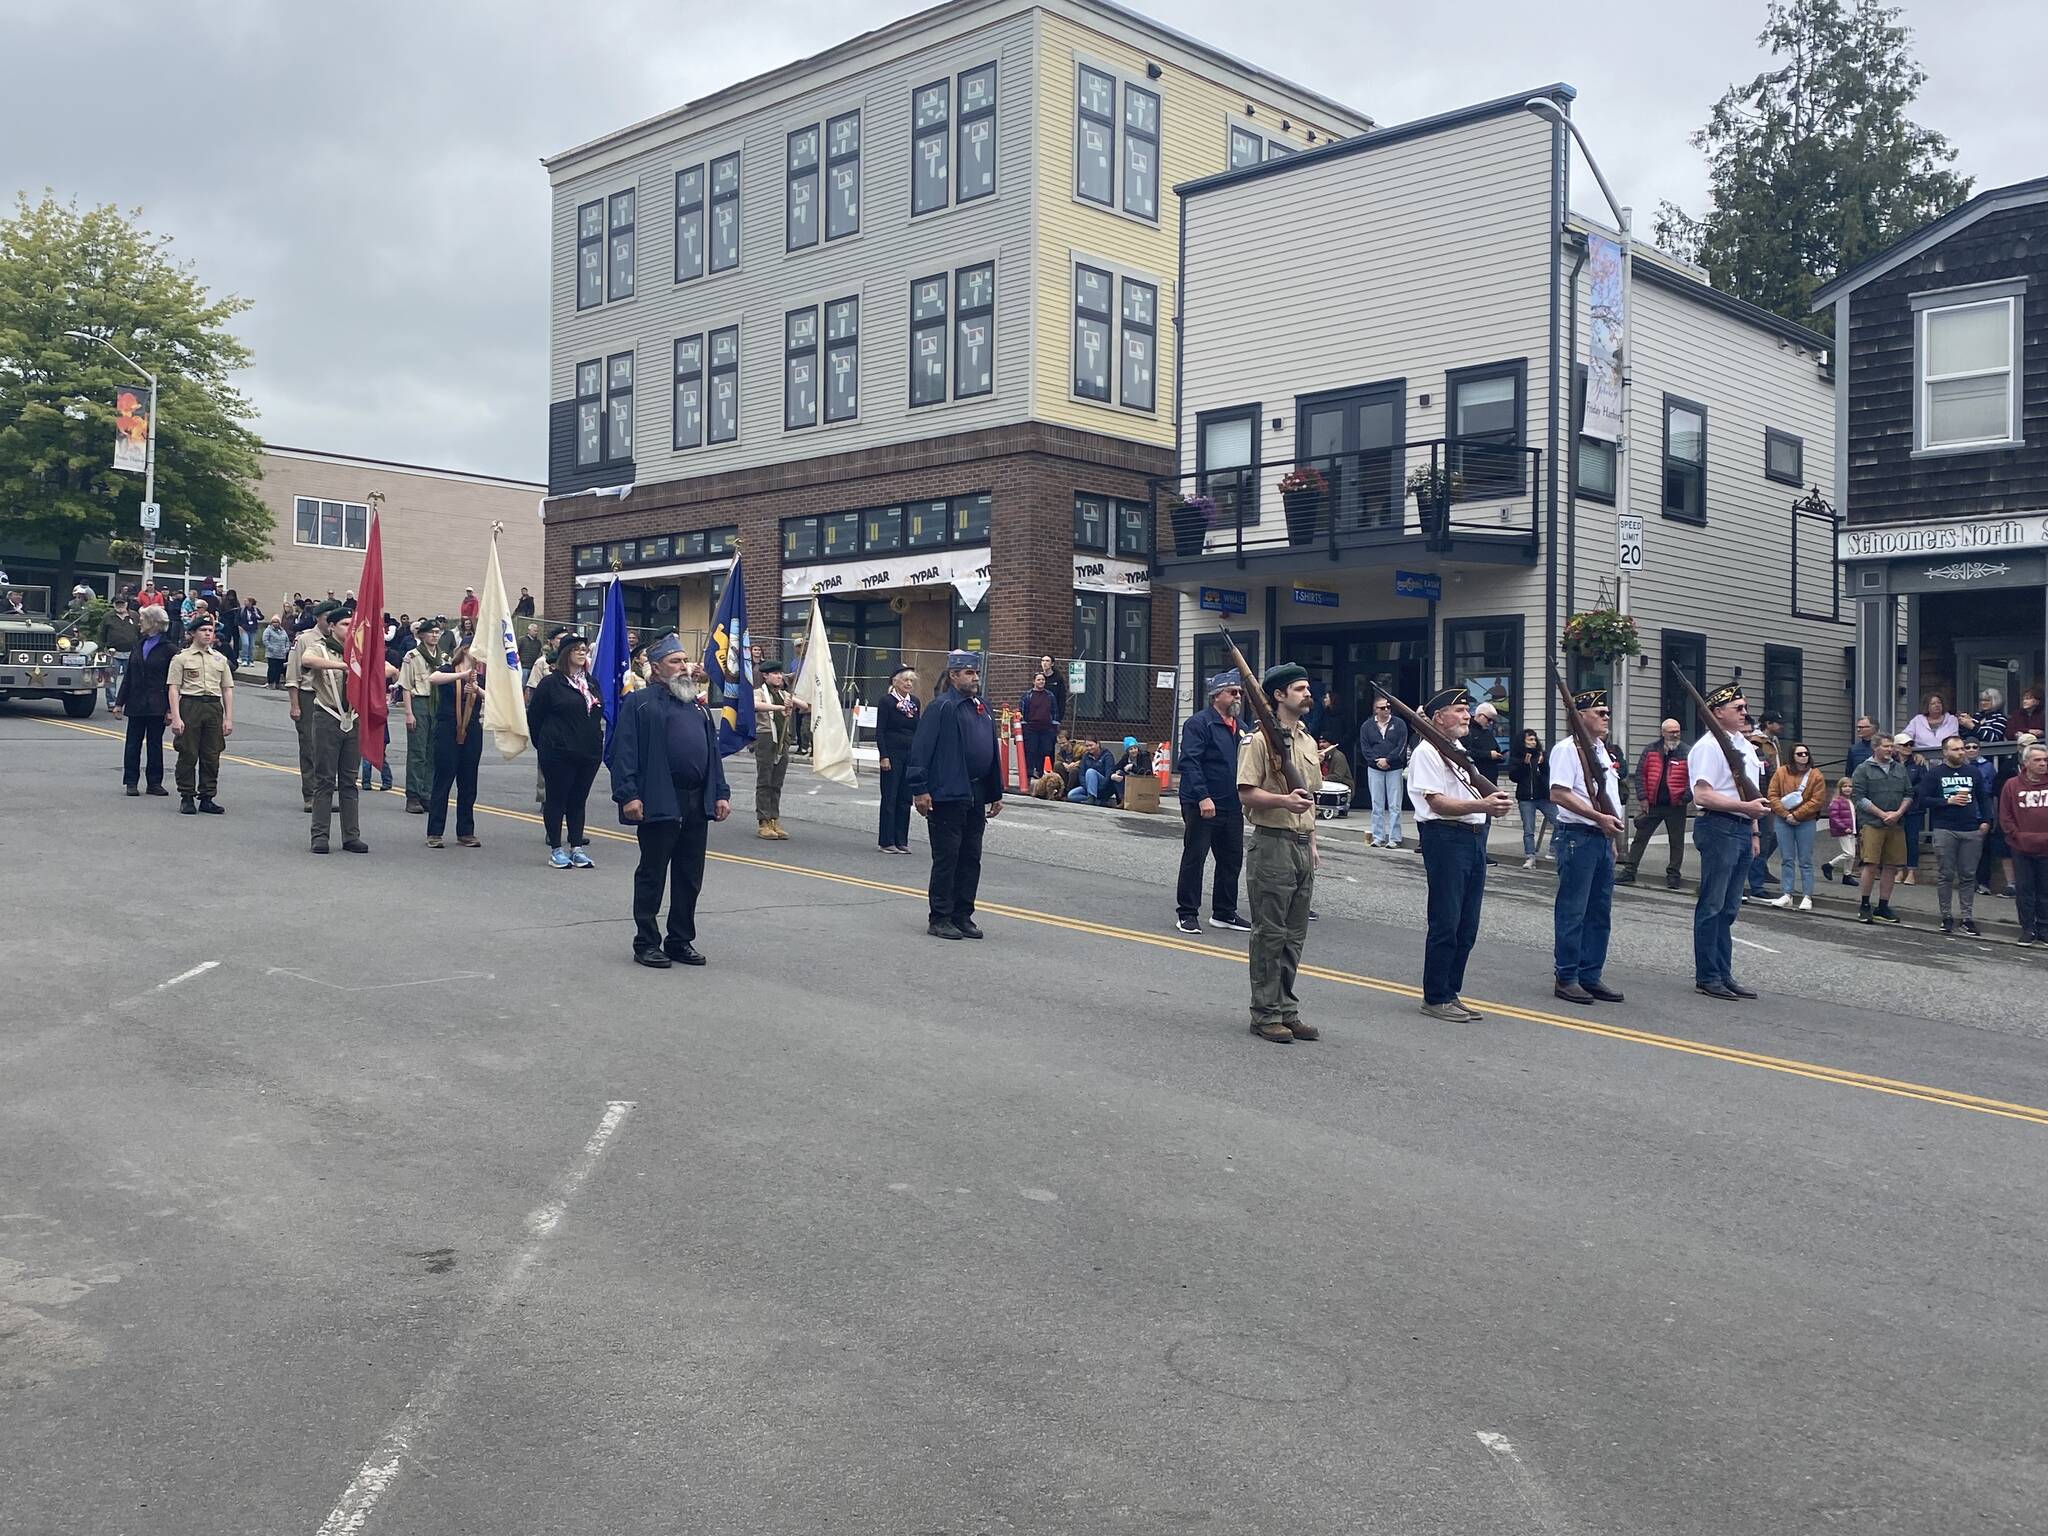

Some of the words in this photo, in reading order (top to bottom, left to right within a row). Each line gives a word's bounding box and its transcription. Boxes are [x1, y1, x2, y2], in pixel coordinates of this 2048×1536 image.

[1586, 400, 1600, 417] Friday
[1603, 405, 1622, 421] Harbor
[147, 507, 155, 516] P
[1620, 520, 1642, 530] SPEED
[1622, 532, 1640, 541] LIMIT
[1848, 530, 1957, 556] Schooners
[1961, 520, 2024, 547] North
[1621, 544, 1641, 565] 20
[862, 571, 890, 589] TYPAR
[910, 566, 939, 585] TYPAR
[1075, 563, 1104, 578] TYPAR
[1224, 593, 1245, 605] WHALE
[1295, 590, 1322, 604] T-SHIRTS
[1941, 776, 1973, 787] SEATTLE
